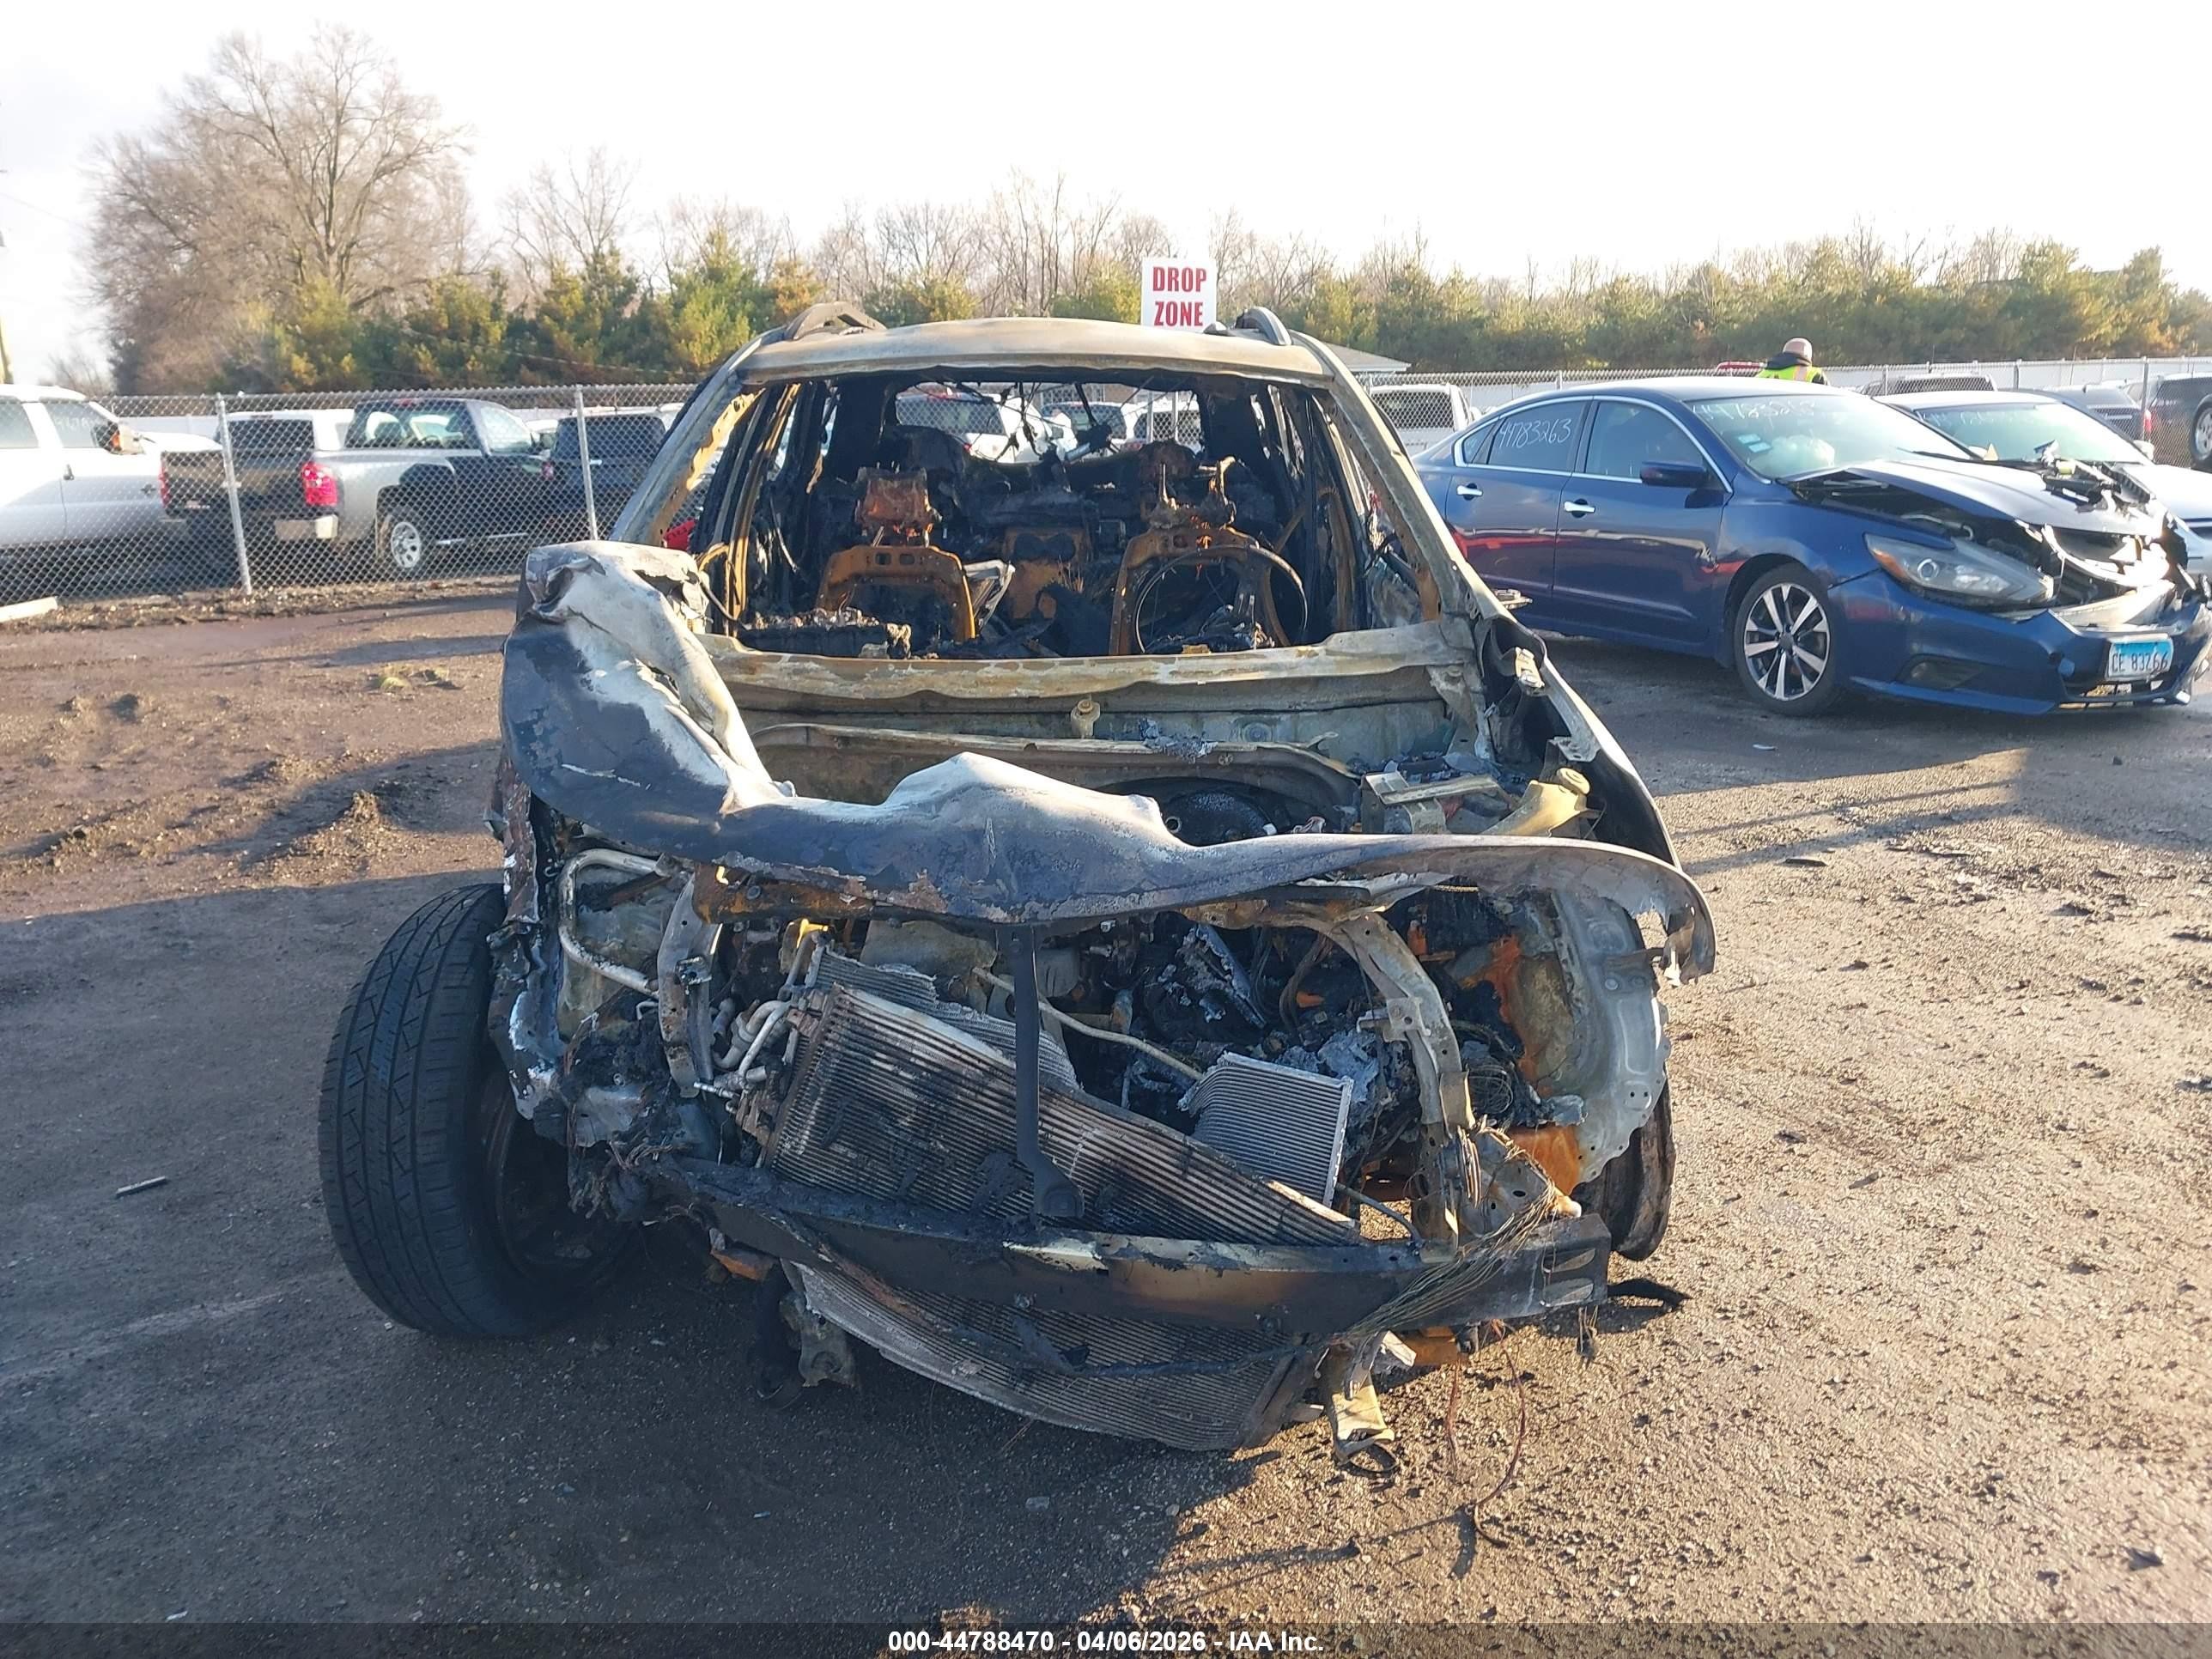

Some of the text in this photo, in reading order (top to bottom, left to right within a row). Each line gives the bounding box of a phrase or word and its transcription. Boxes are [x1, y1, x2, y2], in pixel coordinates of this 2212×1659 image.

[1152, 266, 1206, 292] DROP
[1153, 301, 1203, 326] ZONE
[2112, 653, 2126, 672] CE
